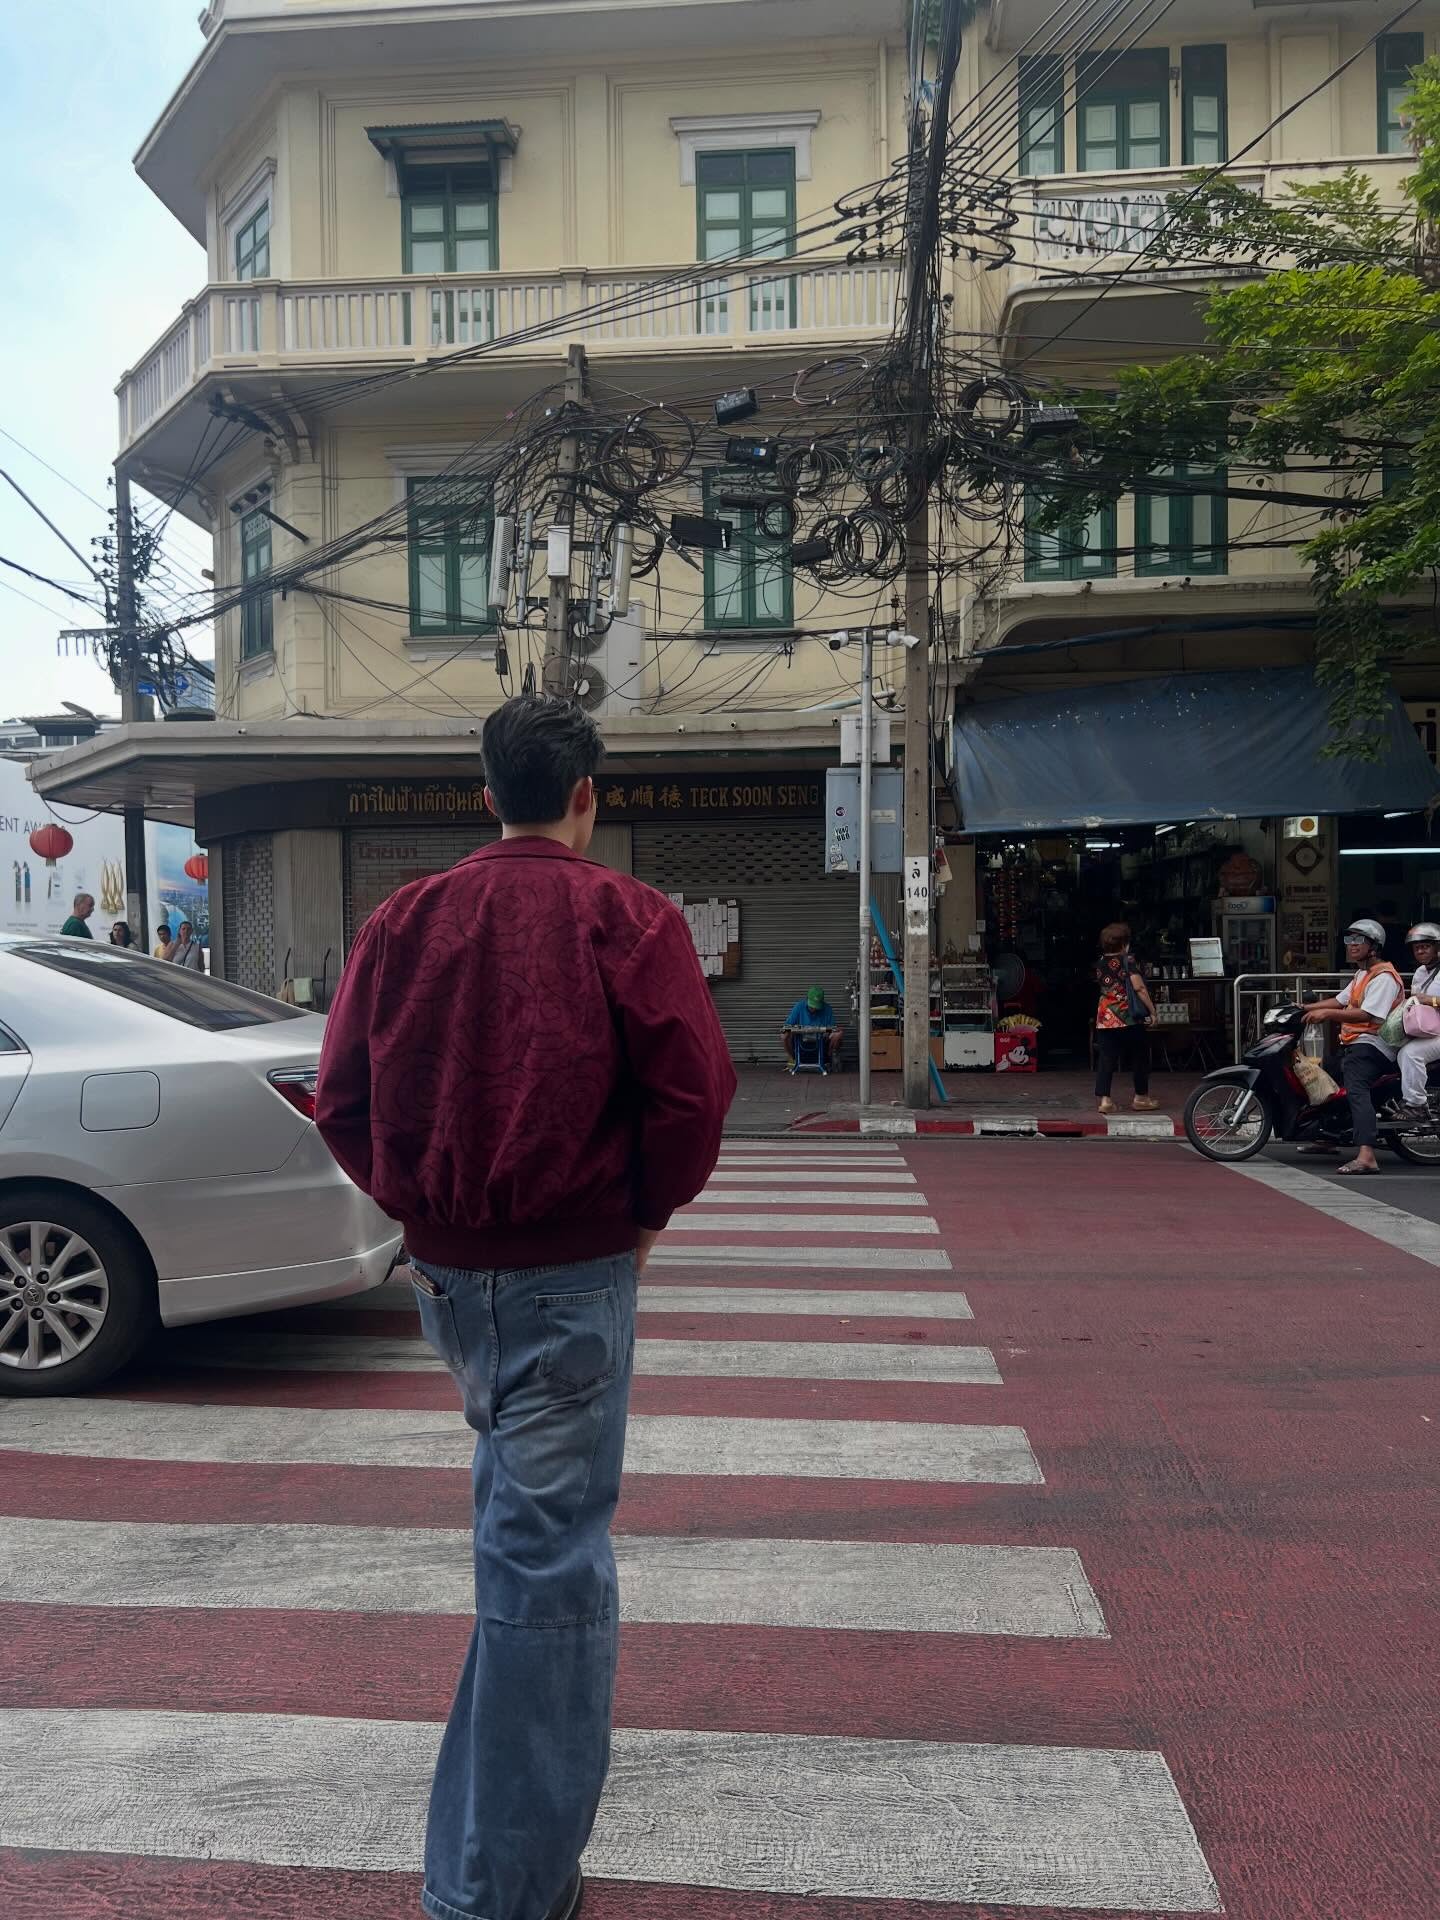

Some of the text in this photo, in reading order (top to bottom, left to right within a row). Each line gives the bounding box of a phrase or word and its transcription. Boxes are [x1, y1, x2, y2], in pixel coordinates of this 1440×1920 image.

[690, 784, 818, 808] TECK SOON SENG
[907, 886, 928, 898] 140
